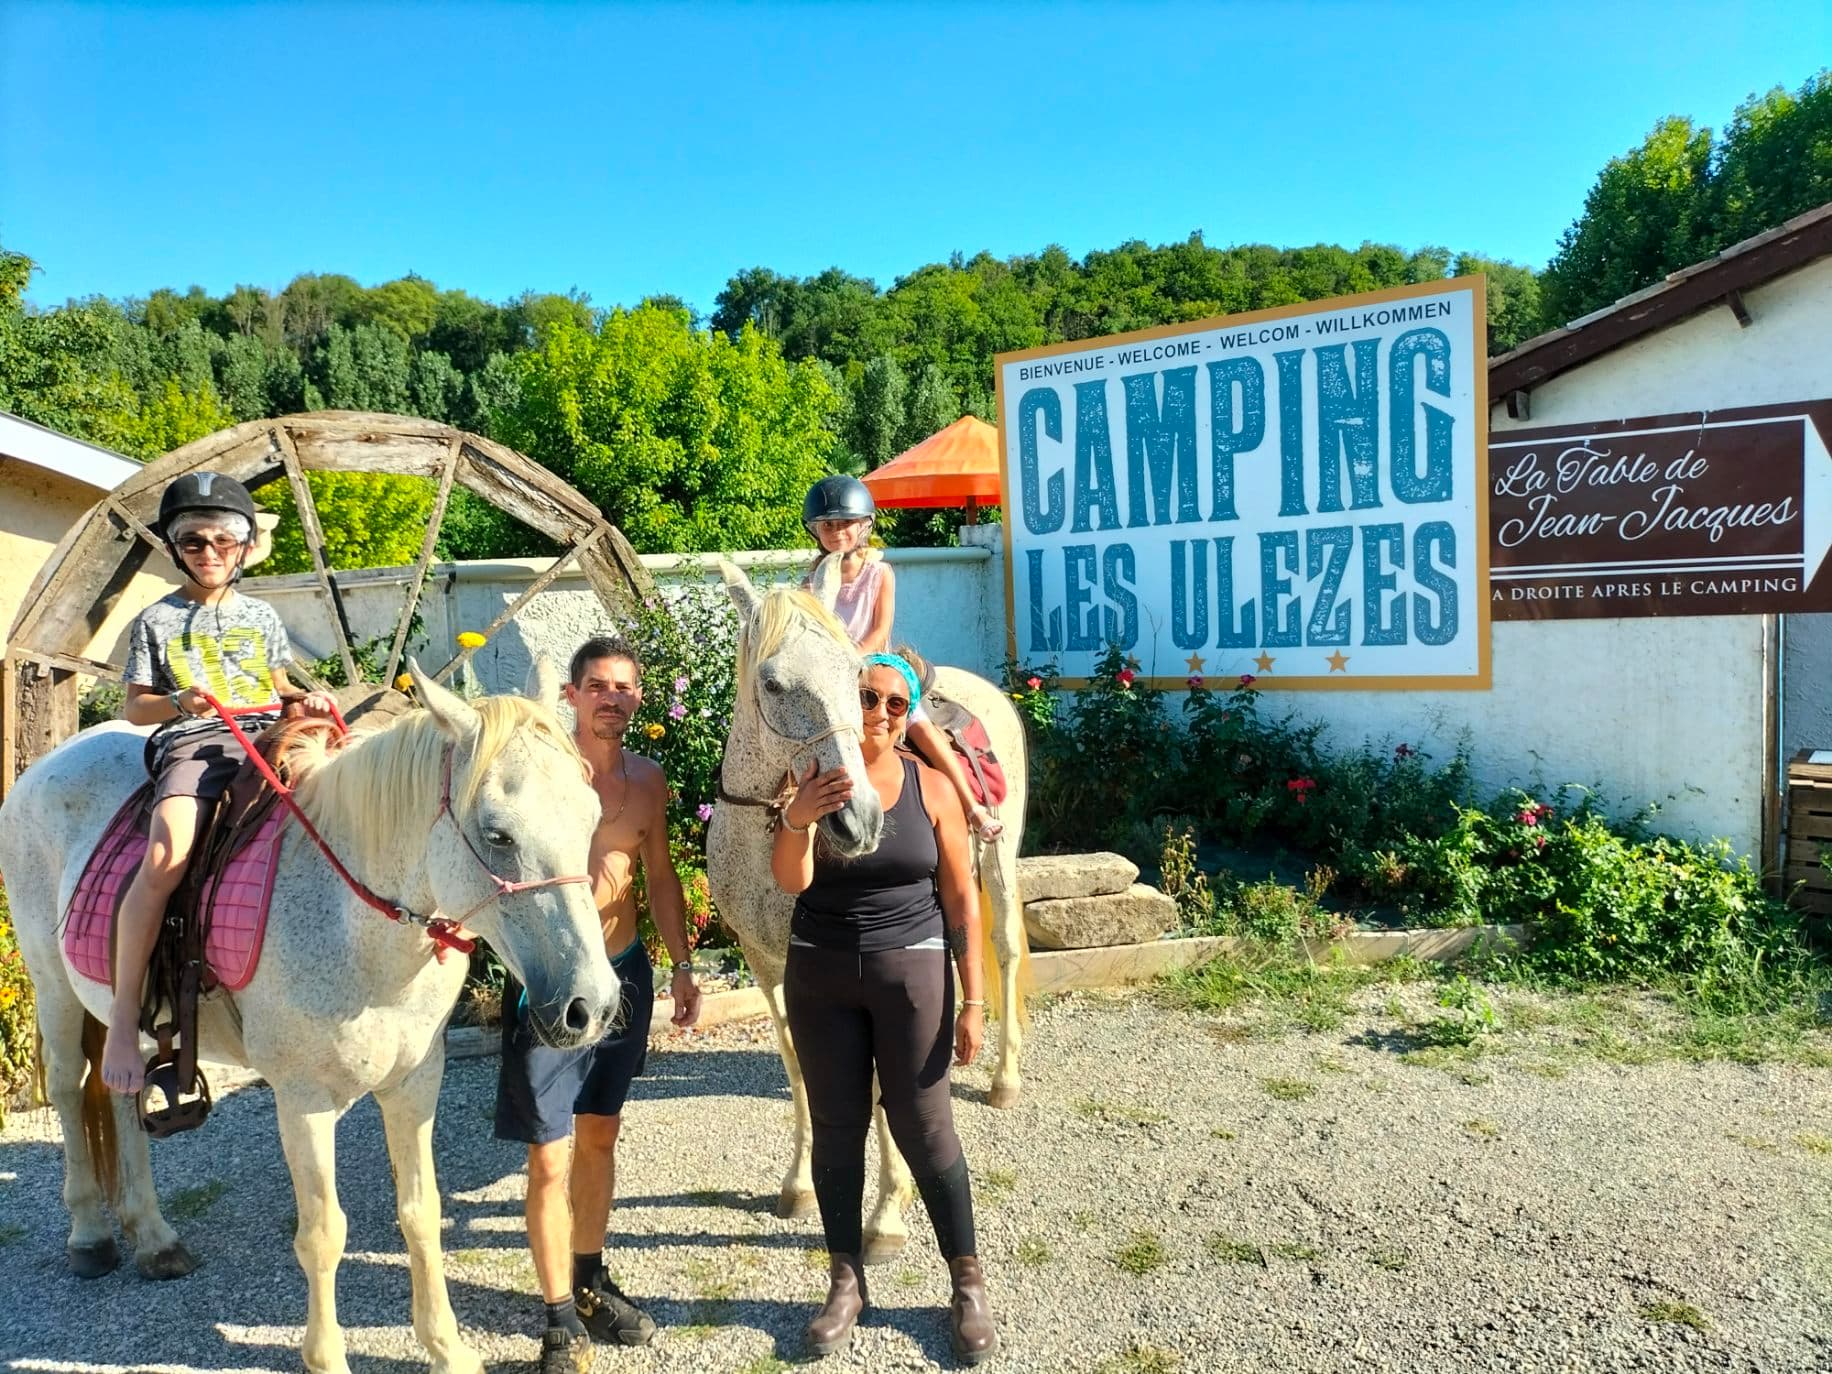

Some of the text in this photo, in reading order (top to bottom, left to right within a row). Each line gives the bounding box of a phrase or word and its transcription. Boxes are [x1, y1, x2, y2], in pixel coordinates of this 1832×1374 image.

[1020, 356, 1104, 380] BIENVENUE
[1118, 340, 1201, 366] WELCOME
[1221, 325, 1300, 350] WELCOM
[1316, 301, 1451, 336] WILLKOMMEN
[1019, 327, 1456, 535] CAMPING
[1495, 447, 1709, 497] La Table de
[1499, 484, 1798, 547] Jean-Jacques
[1026, 521, 1458, 651] LES ULEZES
[1492, 578, 1797, 601] A DROITE APRES LE CAMPING
